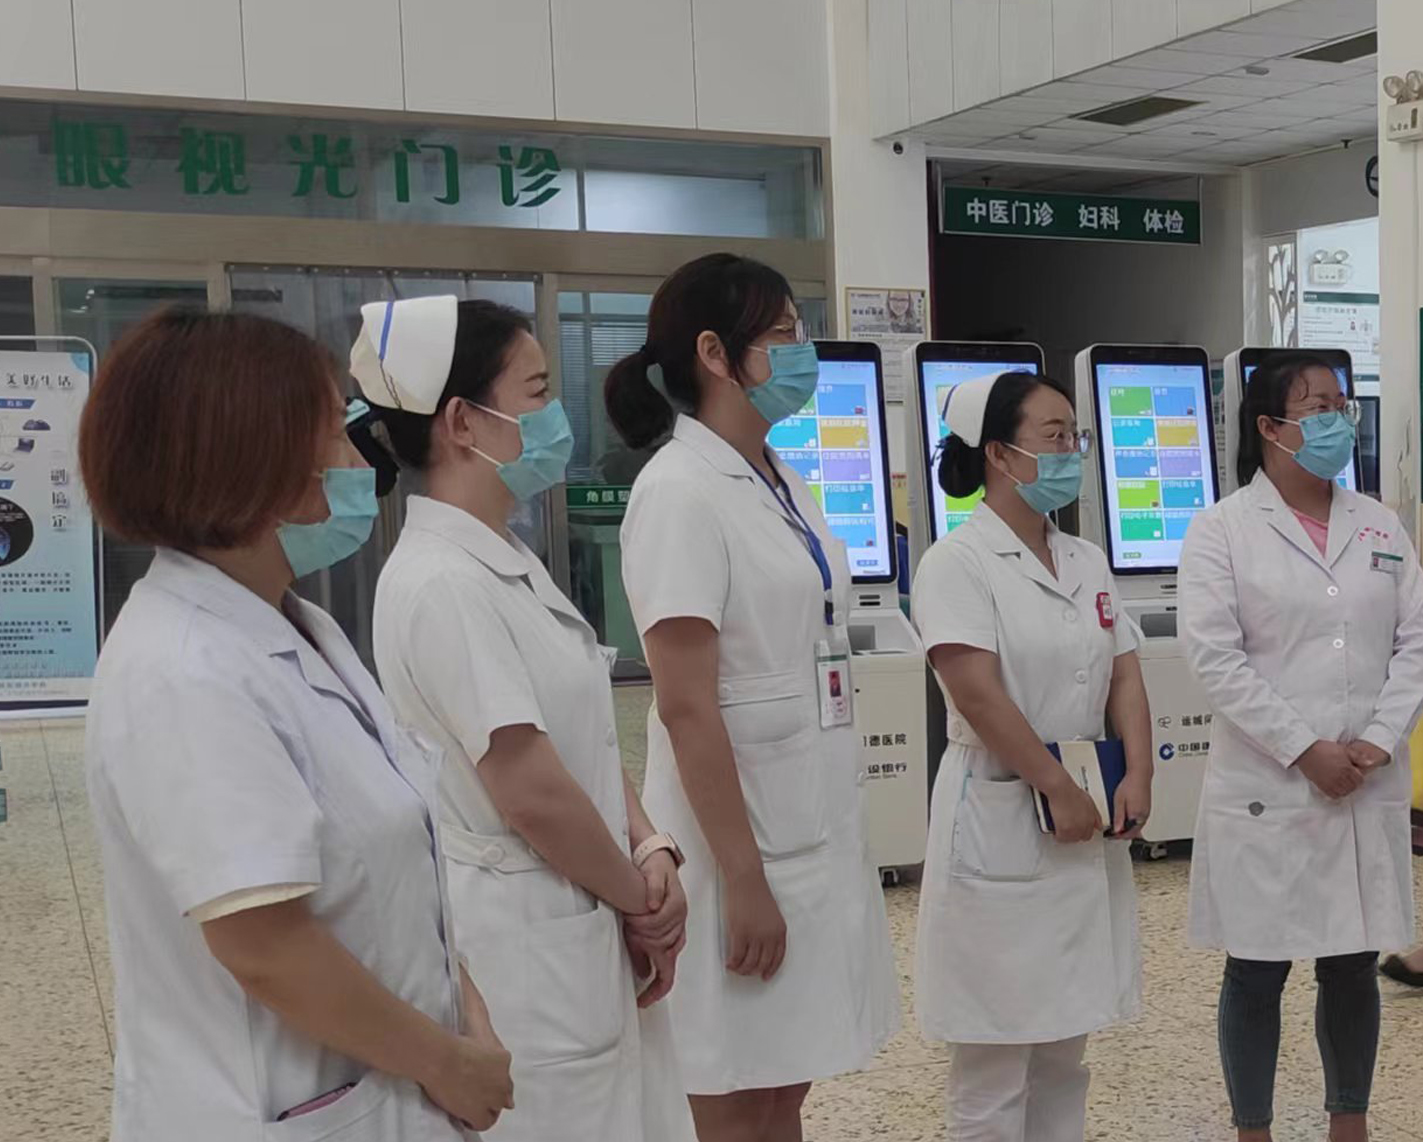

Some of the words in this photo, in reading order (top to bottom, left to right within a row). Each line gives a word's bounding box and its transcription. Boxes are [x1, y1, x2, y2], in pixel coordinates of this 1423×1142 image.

[52, 119, 563, 208] 眼视光门诊
[966, 198, 1054, 227] 中医门诊
[1079, 205, 1121, 231] 妇科
[1143, 208, 1185, 234] 体检
[863, 732, 907, 748] 德医院
